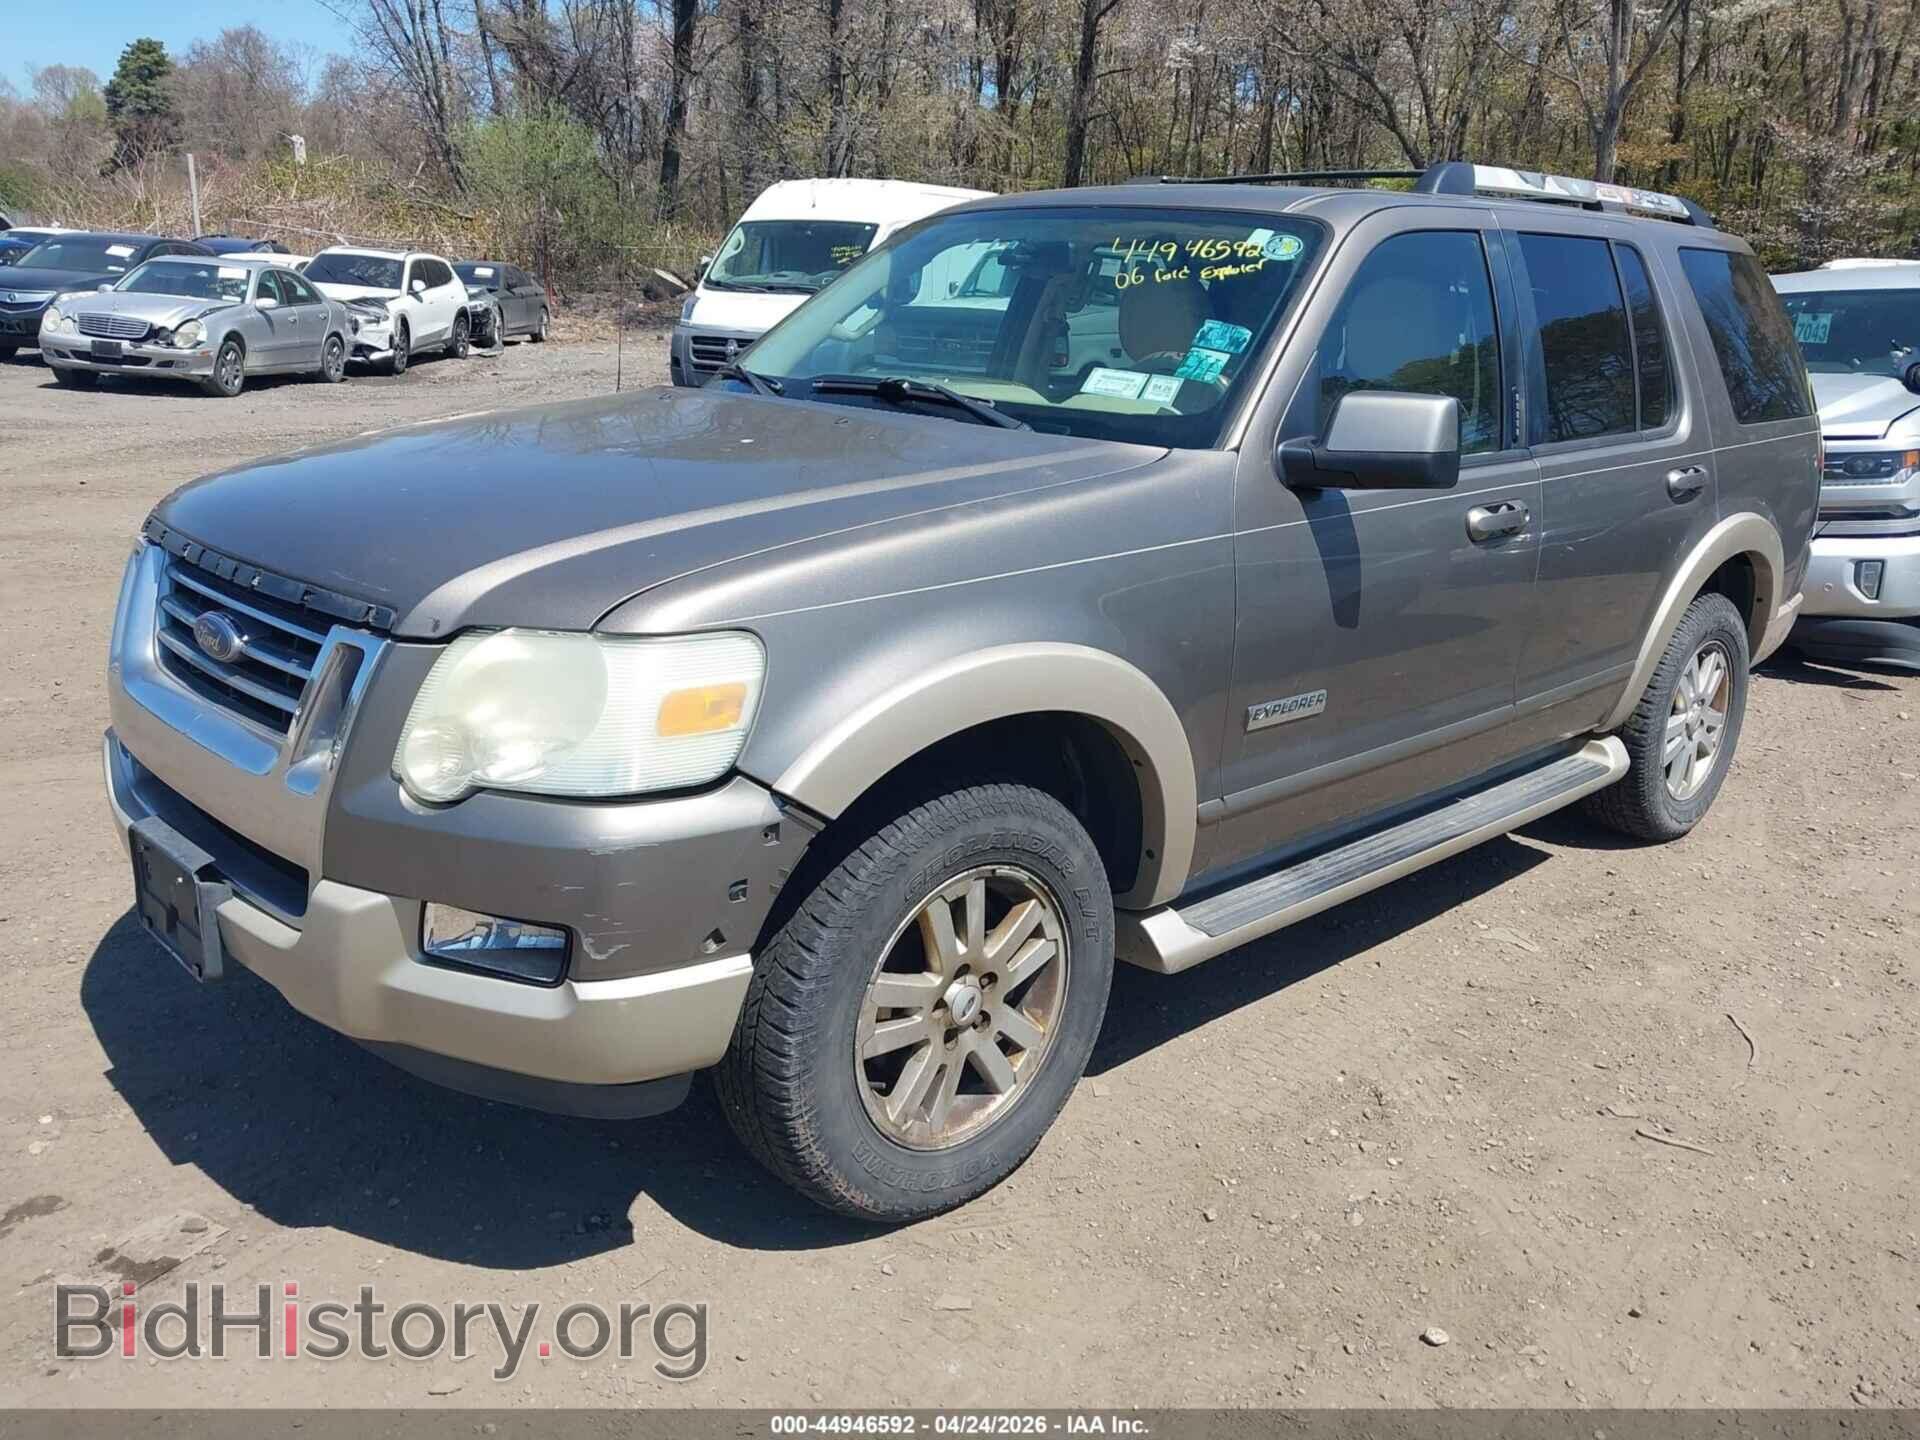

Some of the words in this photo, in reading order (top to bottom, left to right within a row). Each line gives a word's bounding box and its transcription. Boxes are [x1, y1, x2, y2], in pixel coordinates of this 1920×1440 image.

[1115, 266, 1145, 289] 06
[198, 625, 222, 652] Ford
[1252, 692, 1326, 721] EXPLORER
[851, 1137, 1001, 1192] YOKOHAMA
